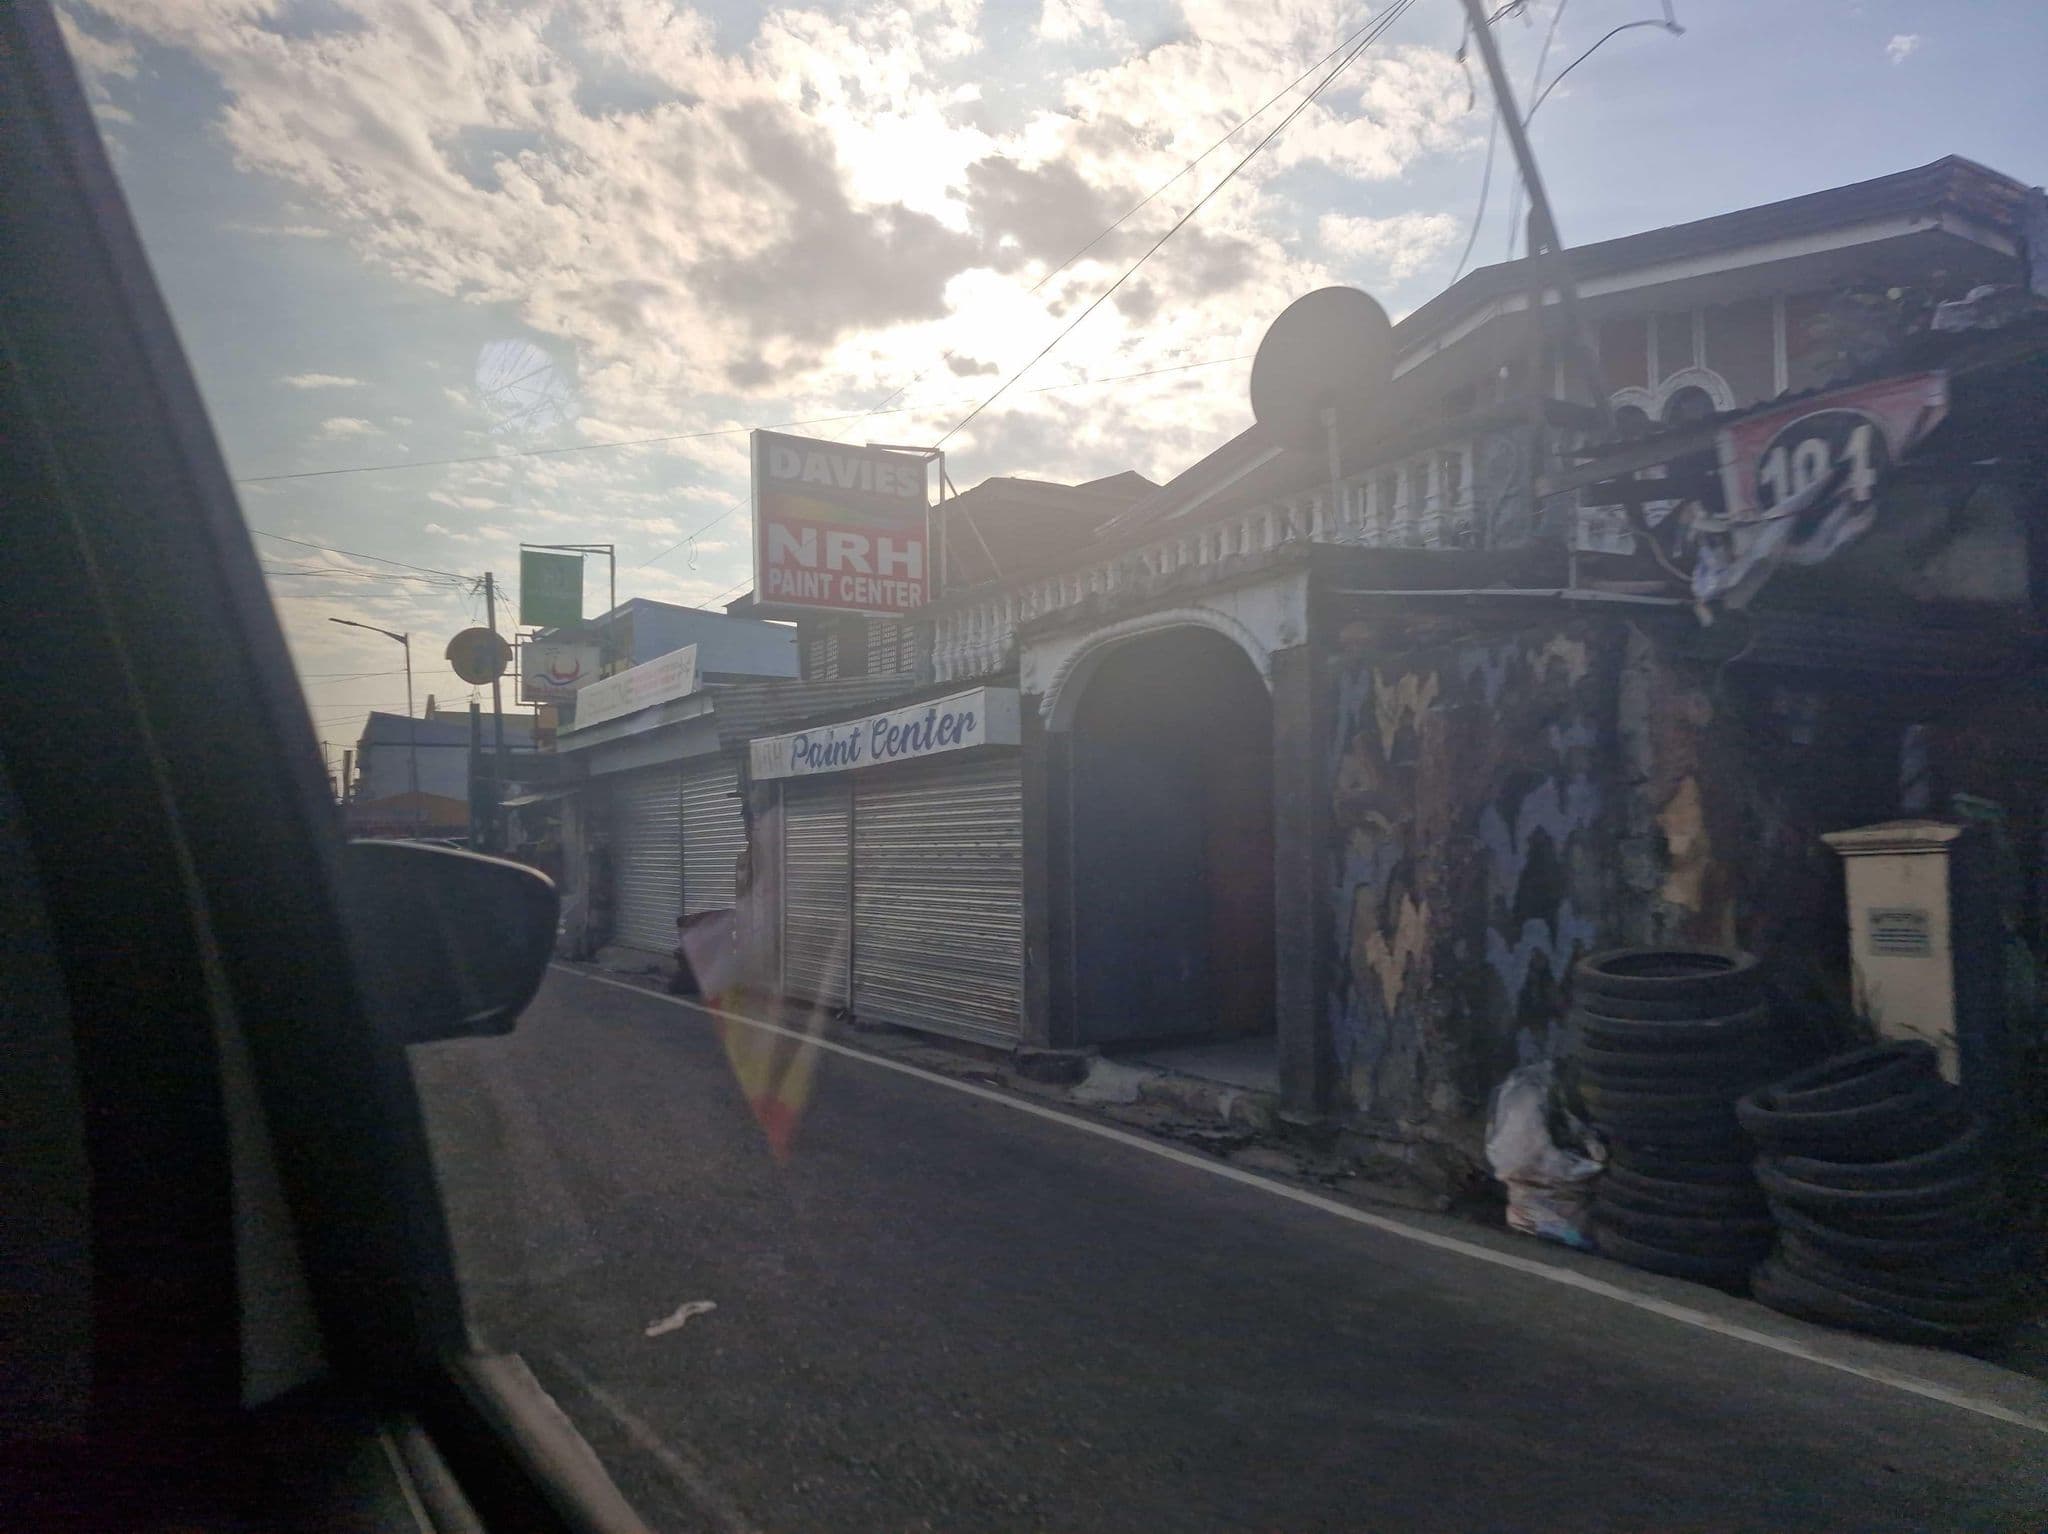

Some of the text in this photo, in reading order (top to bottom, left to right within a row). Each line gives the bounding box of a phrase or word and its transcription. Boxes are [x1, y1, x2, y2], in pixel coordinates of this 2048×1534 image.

[768, 444, 920, 498] DAVIES
[1761, 424, 1878, 504] 101
[767, 522, 923, 579] NRH
[767, 567, 923, 609] PAINT CENTER
[790, 726, 862, 771] Paint
[871, 708, 978, 760] Center
